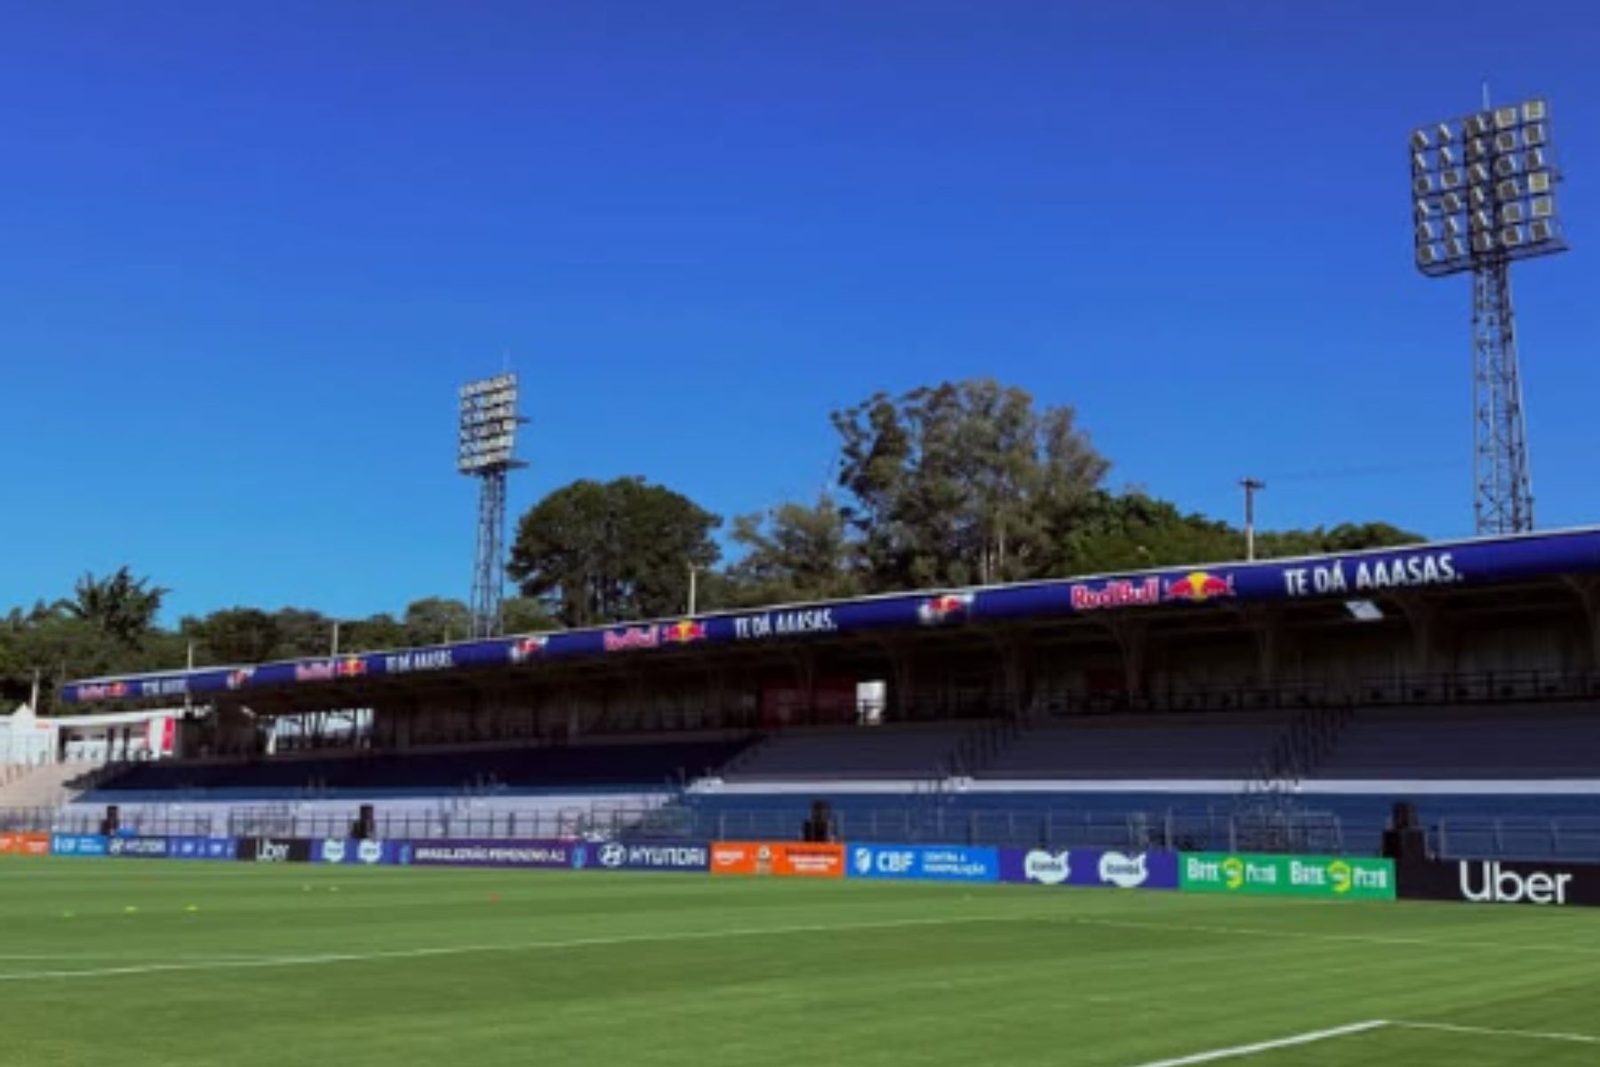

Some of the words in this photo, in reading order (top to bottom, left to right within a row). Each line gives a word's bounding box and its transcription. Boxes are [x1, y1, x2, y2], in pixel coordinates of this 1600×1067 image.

[1284, 568, 1309, 596] TE
[1313, 559, 1347, 594] DÁ
[1356, 552, 1464, 590] AAASAS.
[735, 616, 750, 638] TE
[629, 847, 705, 866] HYUNDAI
[876, 851, 914, 872] CBF
[1460, 859, 1573, 905] Uber
